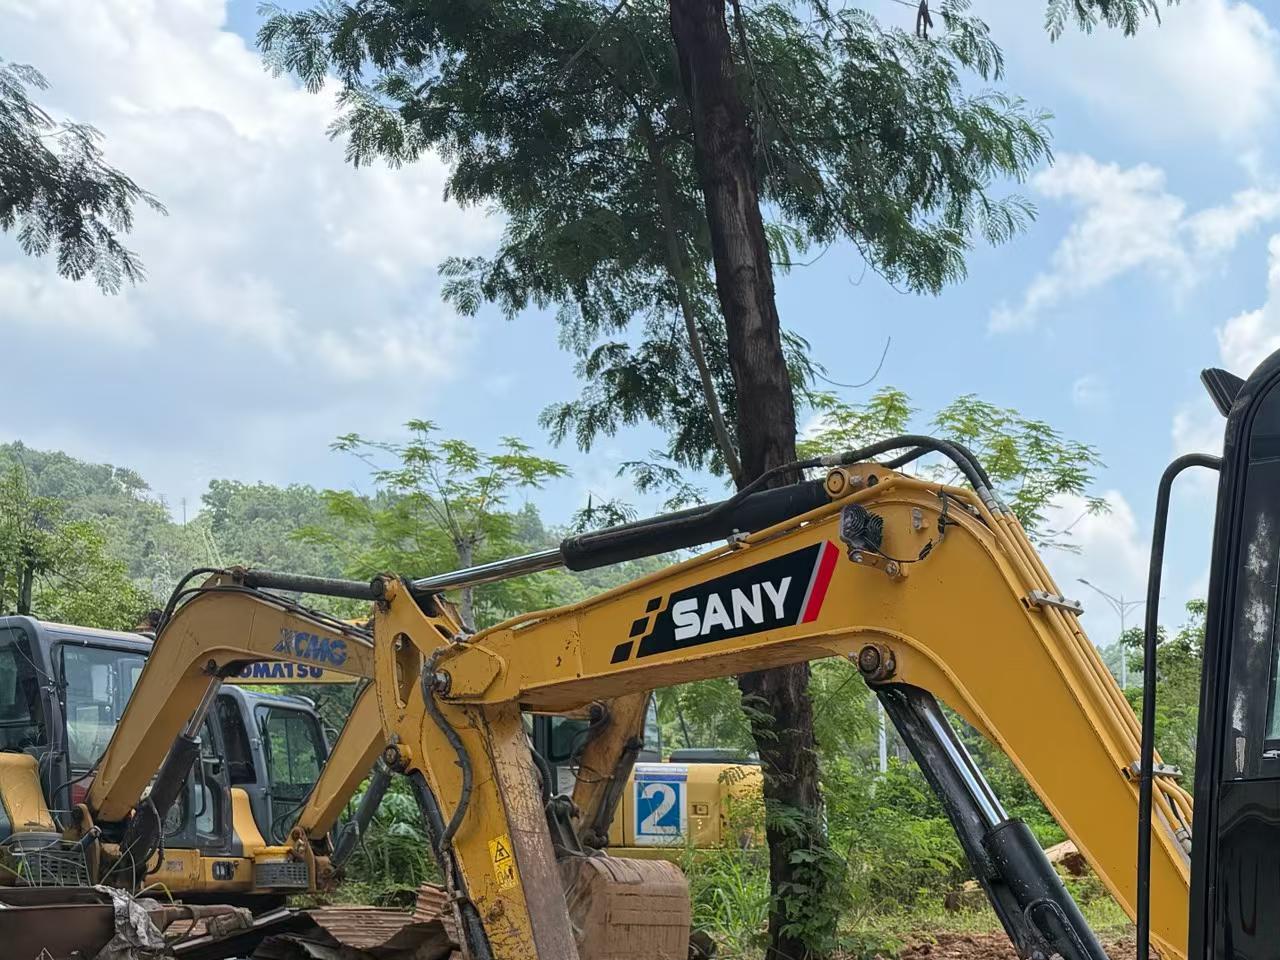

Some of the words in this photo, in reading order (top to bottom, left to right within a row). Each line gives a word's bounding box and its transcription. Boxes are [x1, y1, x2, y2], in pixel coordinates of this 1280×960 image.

[672, 576, 792, 641] SANY
[272, 627, 347, 666] XCMG
[239, 662, 323, 679] OMATSU
[640, 783, 677, 834] 2
